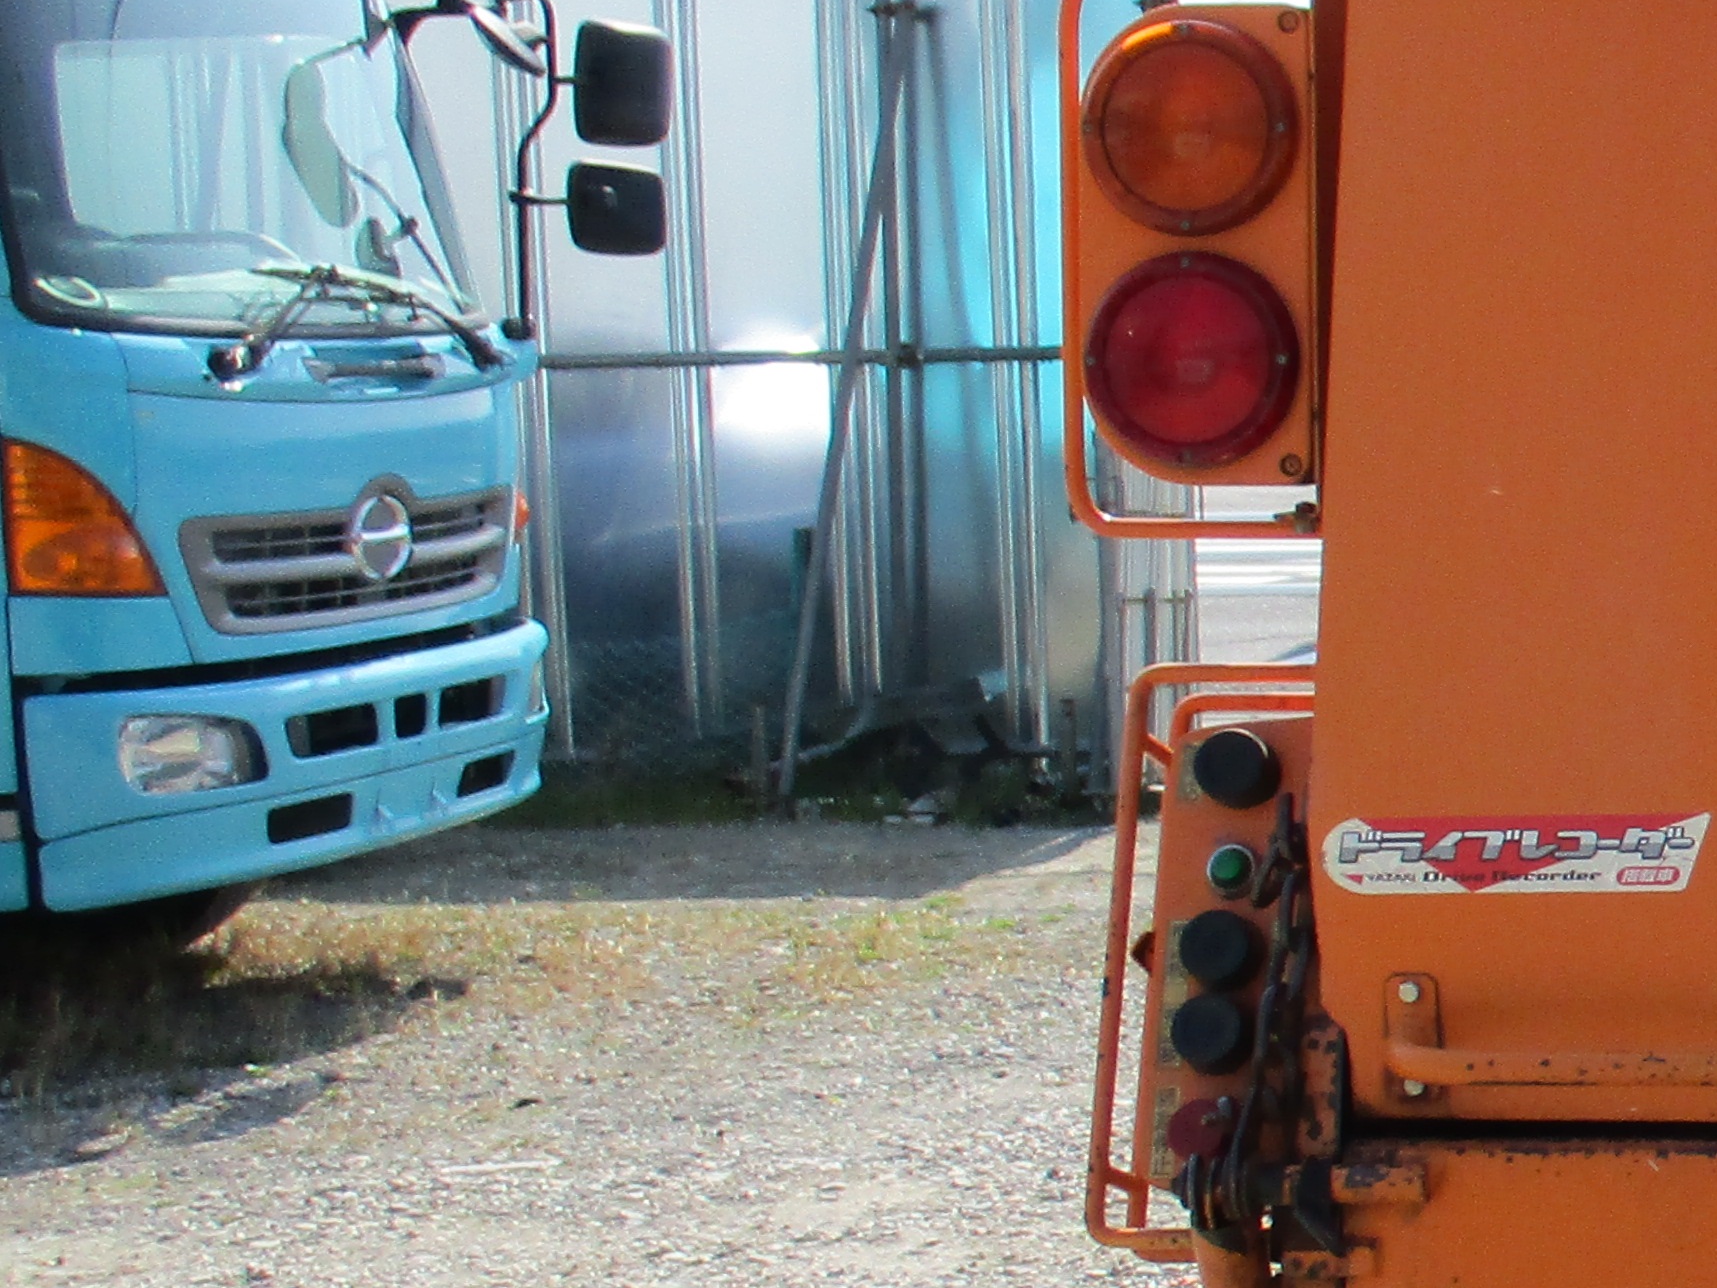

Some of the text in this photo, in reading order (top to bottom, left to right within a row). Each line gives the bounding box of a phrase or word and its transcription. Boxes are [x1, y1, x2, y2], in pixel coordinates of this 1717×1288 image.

[1338, 826, 1696, 863] ドライブレコーダー
